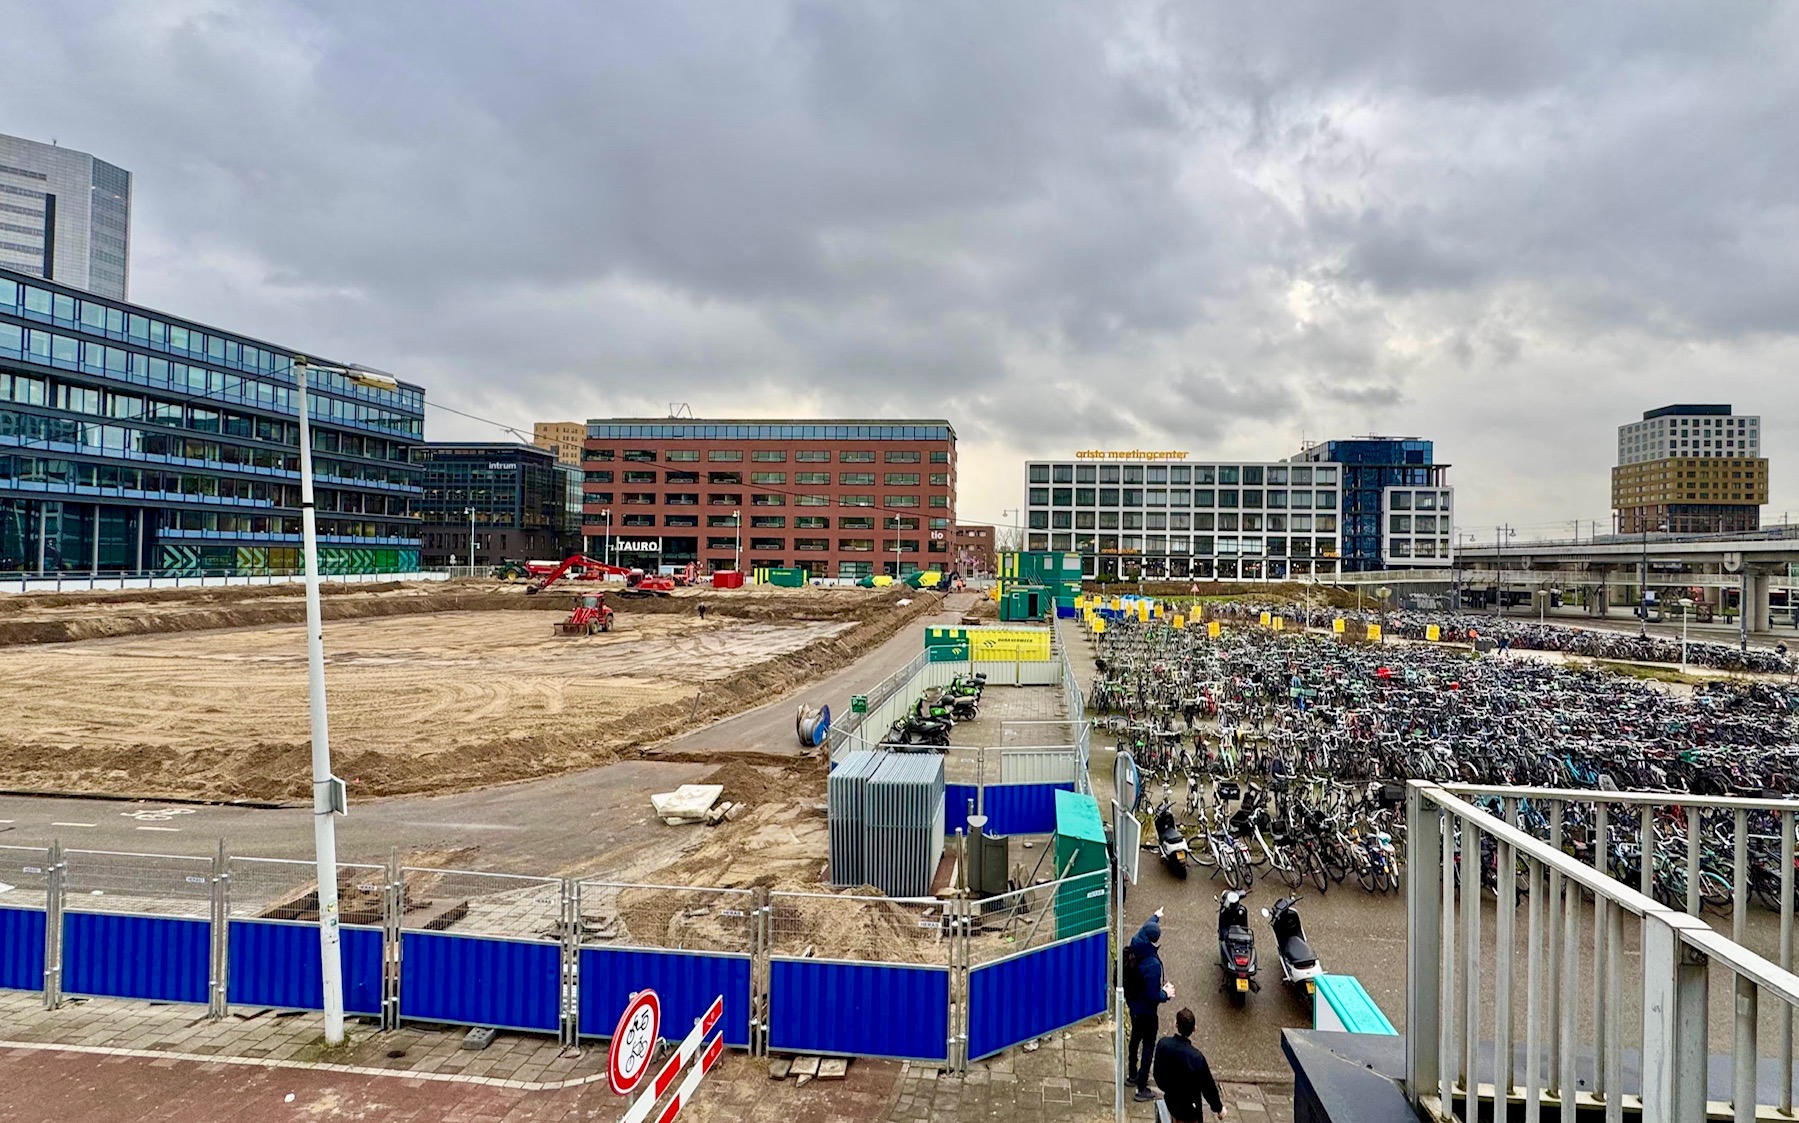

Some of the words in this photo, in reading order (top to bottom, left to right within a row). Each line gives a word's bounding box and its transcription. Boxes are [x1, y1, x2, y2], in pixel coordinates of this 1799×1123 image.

[1076, 450, 1105, 458] aristo
[1108, 449, 1189, 460] meetingcenter
[488, 461, 517, 470] intrum
[930, 531, 944, 540] tio
[619, 541, 658, 551] TAURO
